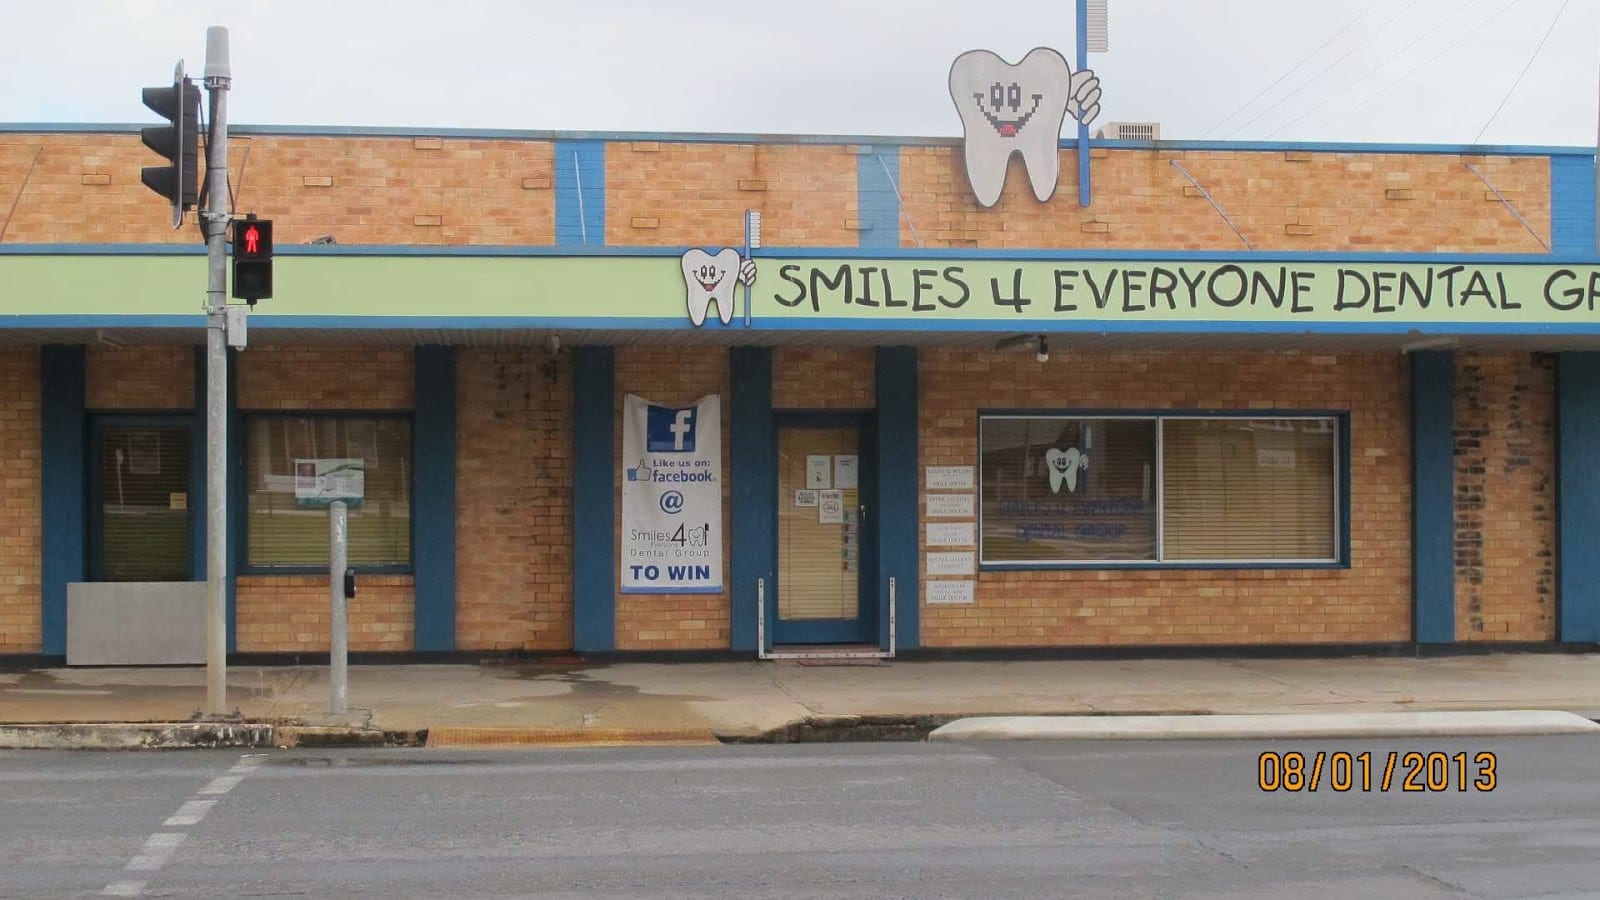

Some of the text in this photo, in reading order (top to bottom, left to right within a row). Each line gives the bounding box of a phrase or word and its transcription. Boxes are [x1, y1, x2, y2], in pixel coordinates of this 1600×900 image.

[774, 264, 970, 312] SMILES
[990, 268, 1031, 312] 4
[1053, 264, 1315, 313] EVERYONE
[1333, 265, 1522, 313] DENTAL
[653, 459, 675, 467] Like
[660, 490, 684, 514] @
[630, 528, 670, 542] Smiles
[630, 548, 710, 559] Dental Group
[630, 564, 710, 581] TO WIN
